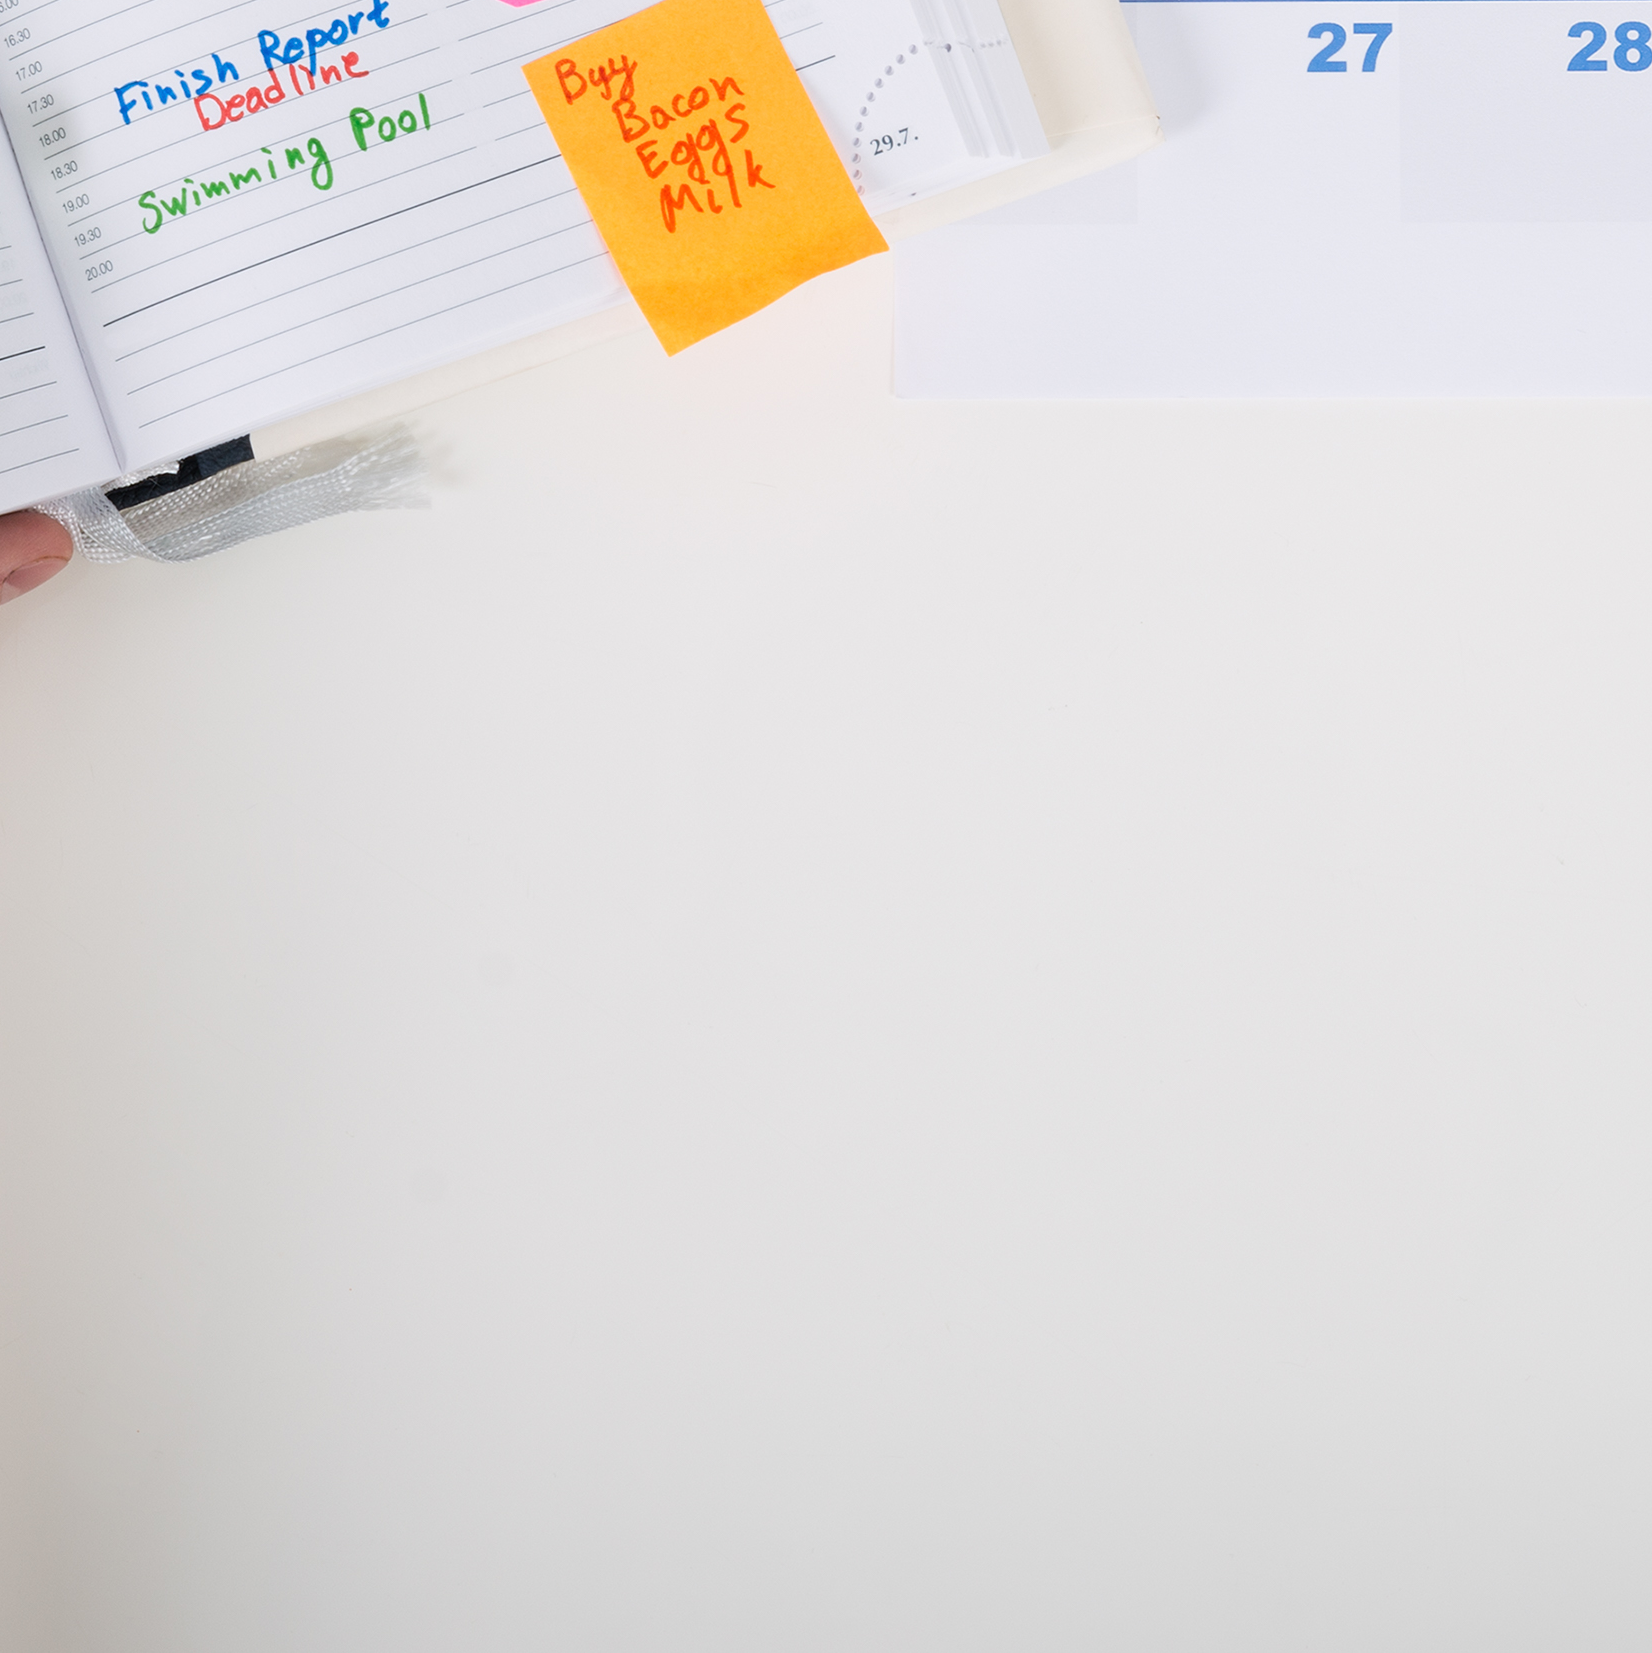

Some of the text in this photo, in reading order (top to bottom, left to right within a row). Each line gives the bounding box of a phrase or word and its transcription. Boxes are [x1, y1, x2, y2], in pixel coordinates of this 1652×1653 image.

[1307, 23, 1392, 72] 27
[1567, 21, 1652, 72] 28
[114, 53, 239, 125] Finish
[194, 51, 370, 131] Deadline
[611, 76, 745, 143] Bacon
[38, 127, 66, 147] 18.00
[138, 92, 431, 234] Swimming Pool
[635, 103, 750, 185] Eggs
[870, 127, 919, 156] 29.7.
[660, 149, 776, 233] Milk
